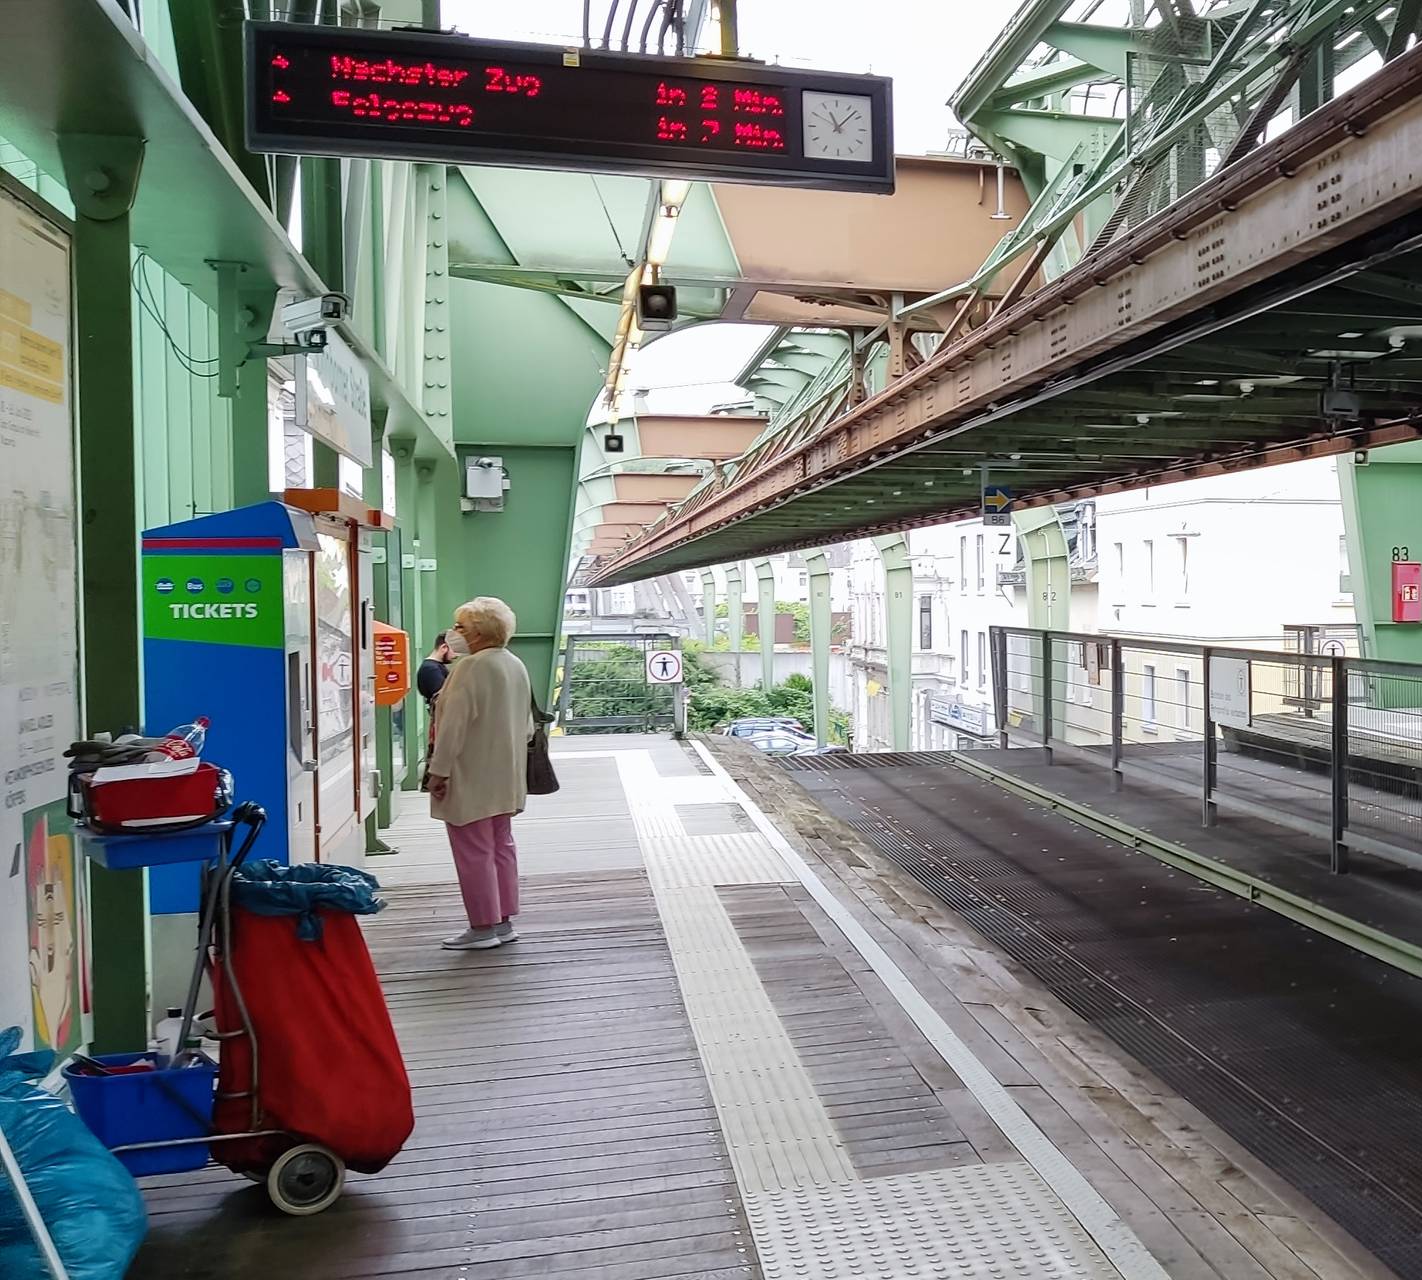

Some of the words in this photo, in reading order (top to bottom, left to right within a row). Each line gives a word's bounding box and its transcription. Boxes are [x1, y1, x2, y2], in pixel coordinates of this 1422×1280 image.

[485, 67, 541, 97] Zug
[998, 533, 1012, 555] Z
[1392, 546, 1409, 562] 83
[168, 603, 258, 619] TICKETS
